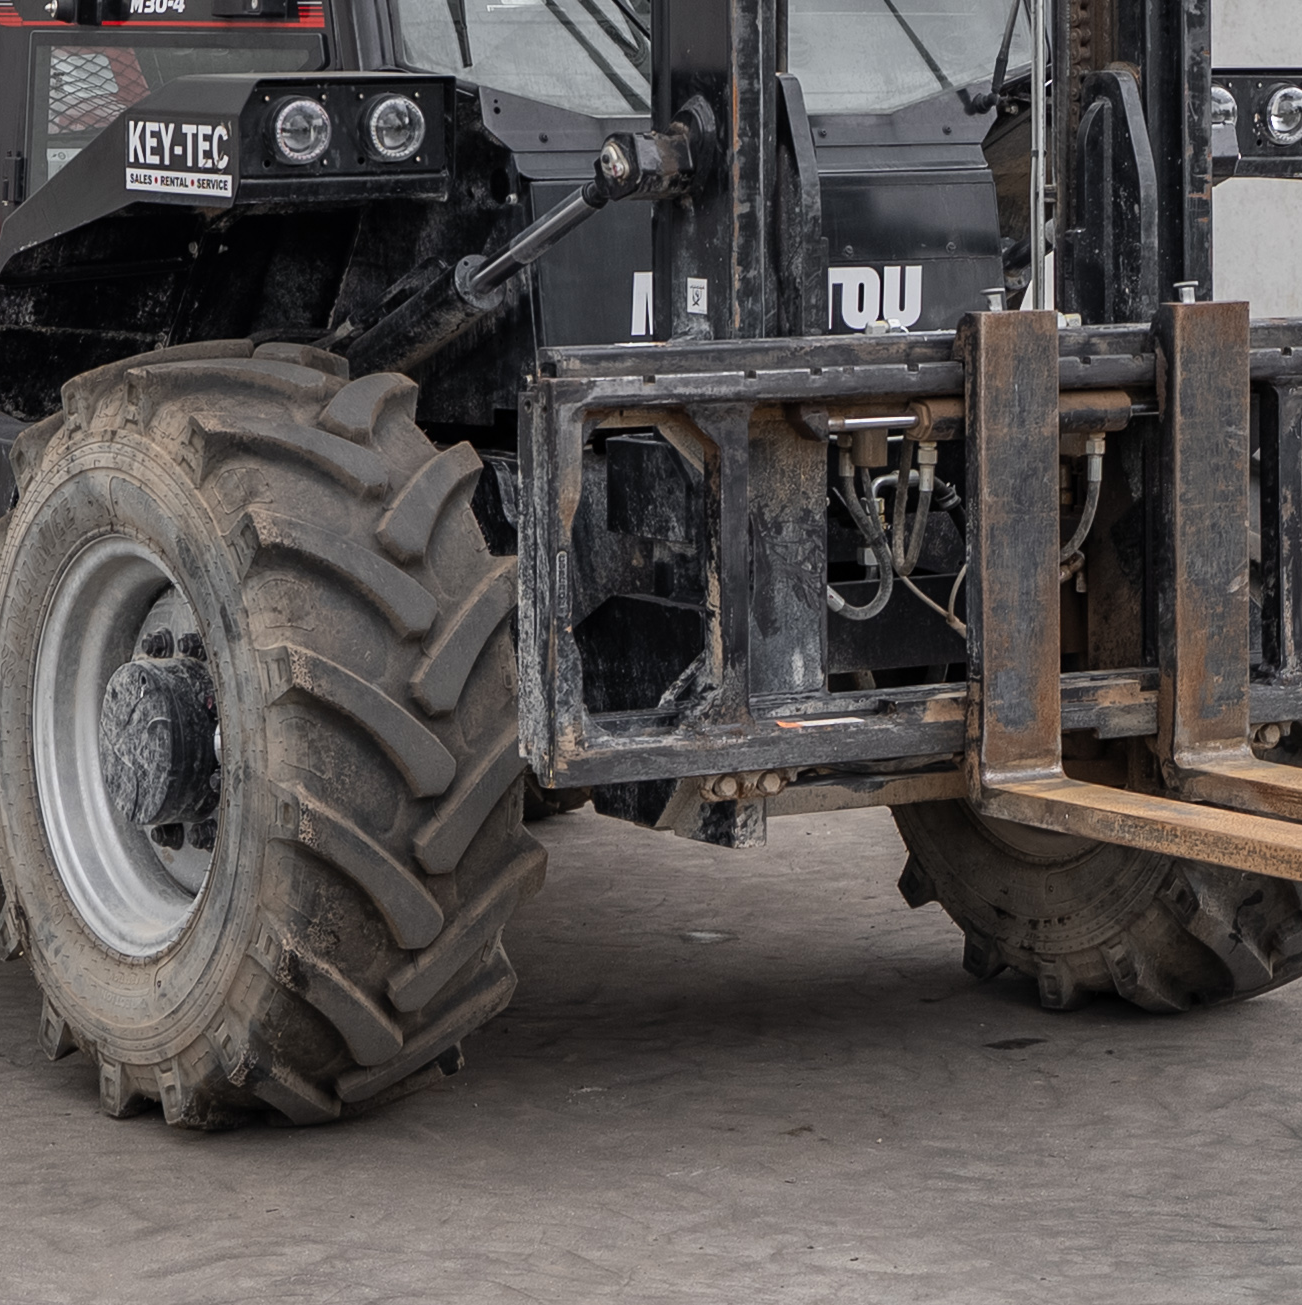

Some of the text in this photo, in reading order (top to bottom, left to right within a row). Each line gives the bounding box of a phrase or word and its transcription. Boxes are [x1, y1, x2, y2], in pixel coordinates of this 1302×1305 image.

[128, 120, 229, 170] KEY-TEC
[129, 173, 229, 191] SALES RENTAL SERVICE
